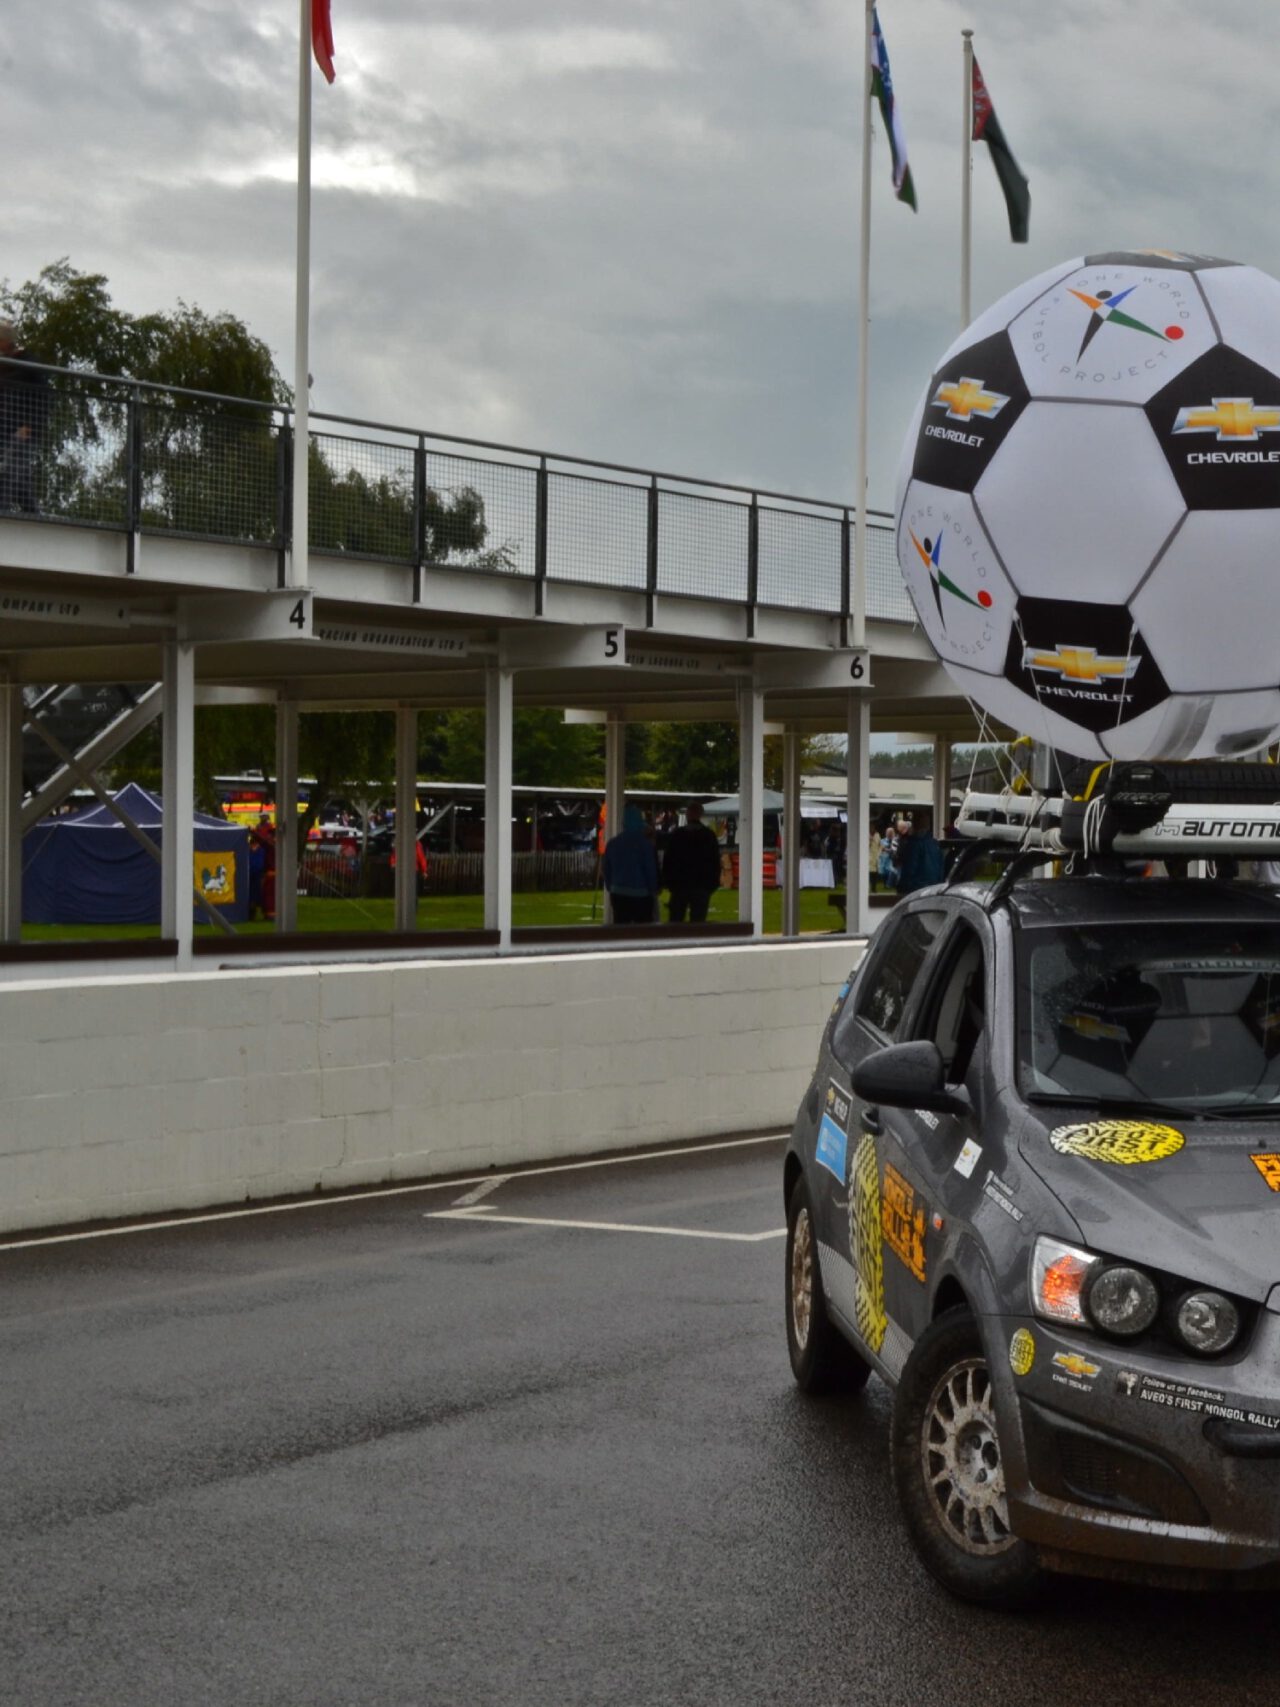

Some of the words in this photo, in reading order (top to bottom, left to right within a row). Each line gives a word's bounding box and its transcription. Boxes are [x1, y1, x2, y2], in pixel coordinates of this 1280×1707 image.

[1059, 350, 1168, 384] PROJECT
[924, 424, 984, 448] CHEVROLET
[289, 599, 306, 629] 4
[604, 630, 618, 657] 5
[850, 656, 864, 680] 6
[1036, 684, 1134, 702] CHEVROLET
[1142, 1376, 1165, 1389] Follow
[1140, 1389, 1173, 1406] AVEO'S
[1174, 1397, 1203, 1412] FIRST
[1204, 1403, 1246, 1422] MONGOL
[1247, 1412, 1280, 1429] RALLY
